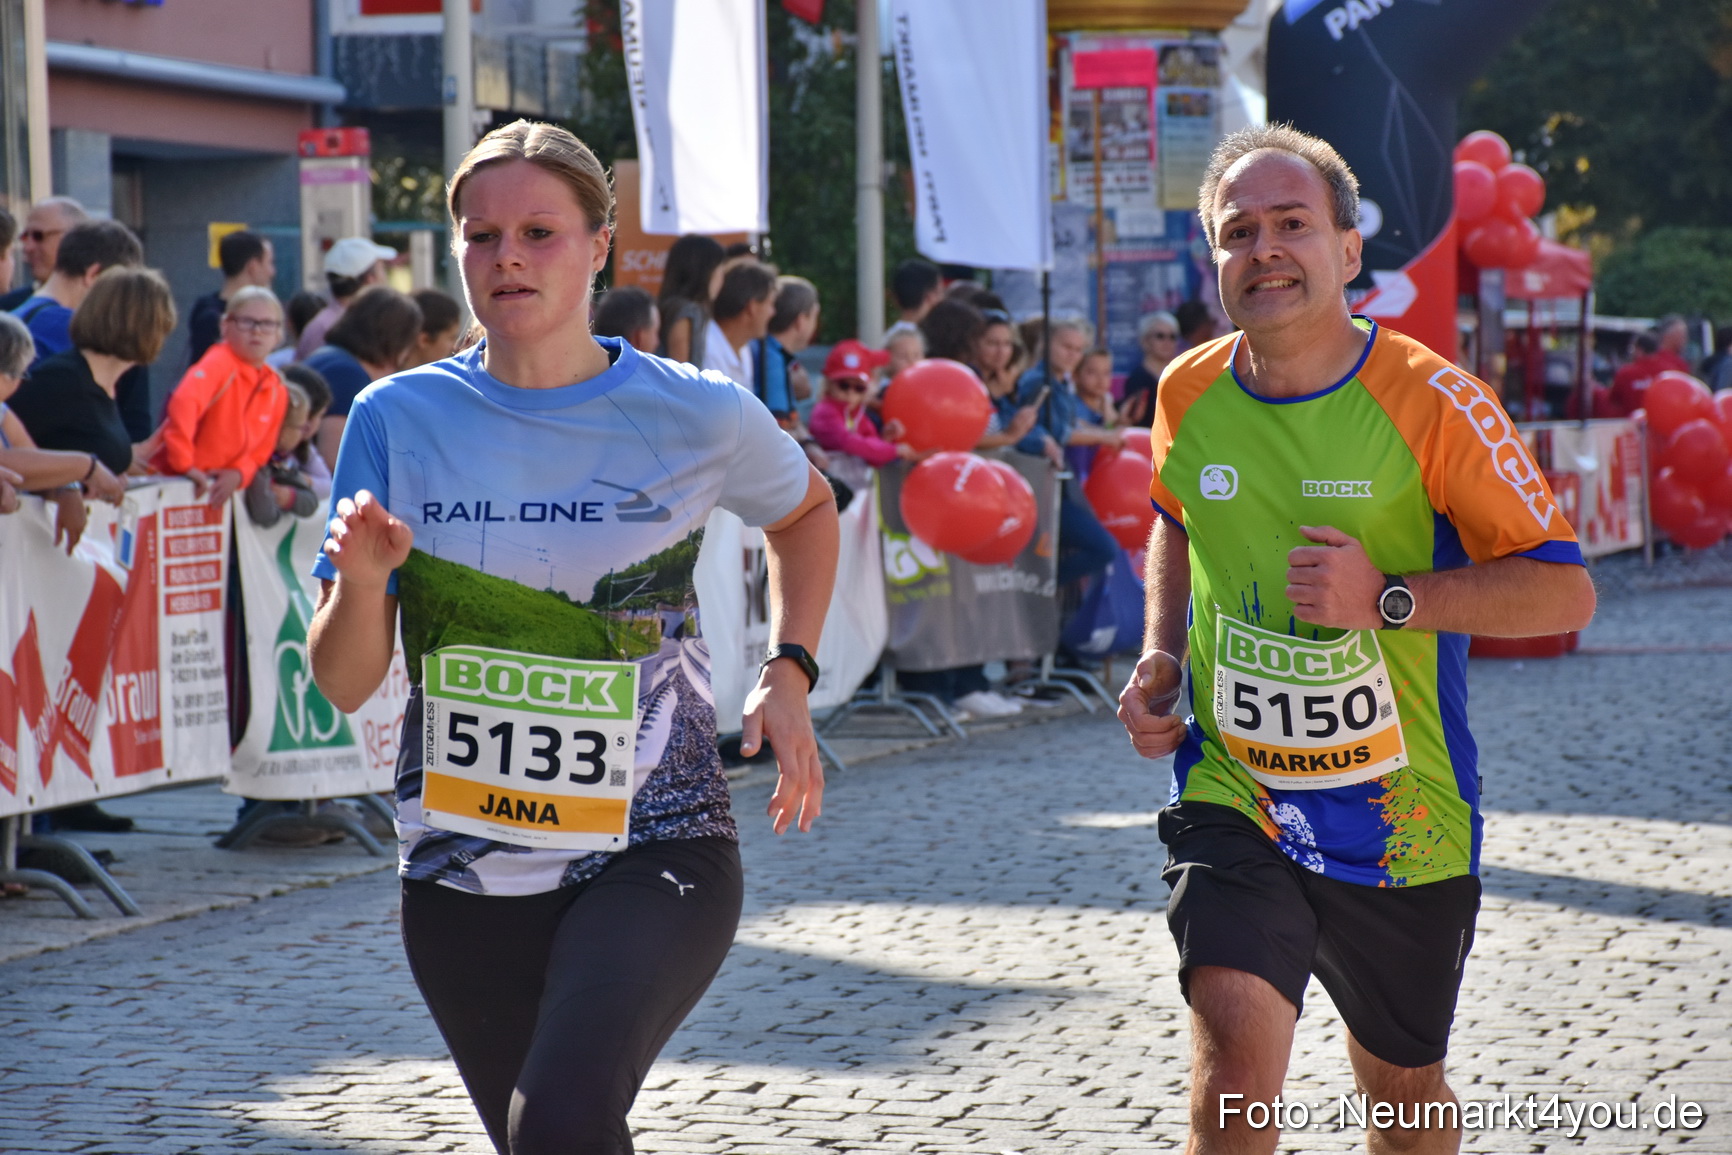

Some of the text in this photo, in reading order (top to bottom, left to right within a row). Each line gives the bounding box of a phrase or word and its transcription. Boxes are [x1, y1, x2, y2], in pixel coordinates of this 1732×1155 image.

[1428, 367, 1554, 531] BOCK
[1302, 480, 1373, 497] BOCK
[1227, 626, 1372, 681] BOCK
[440, 653, 619, 713] BOCK
[1234, 681, 1378, 738] 5150
[446, 711, 607, 785] 5133
[616, 736, 625, 746] S
[1247, 745, 1371, 772] MARKUS
[479, 794, 560, 825] JANA
